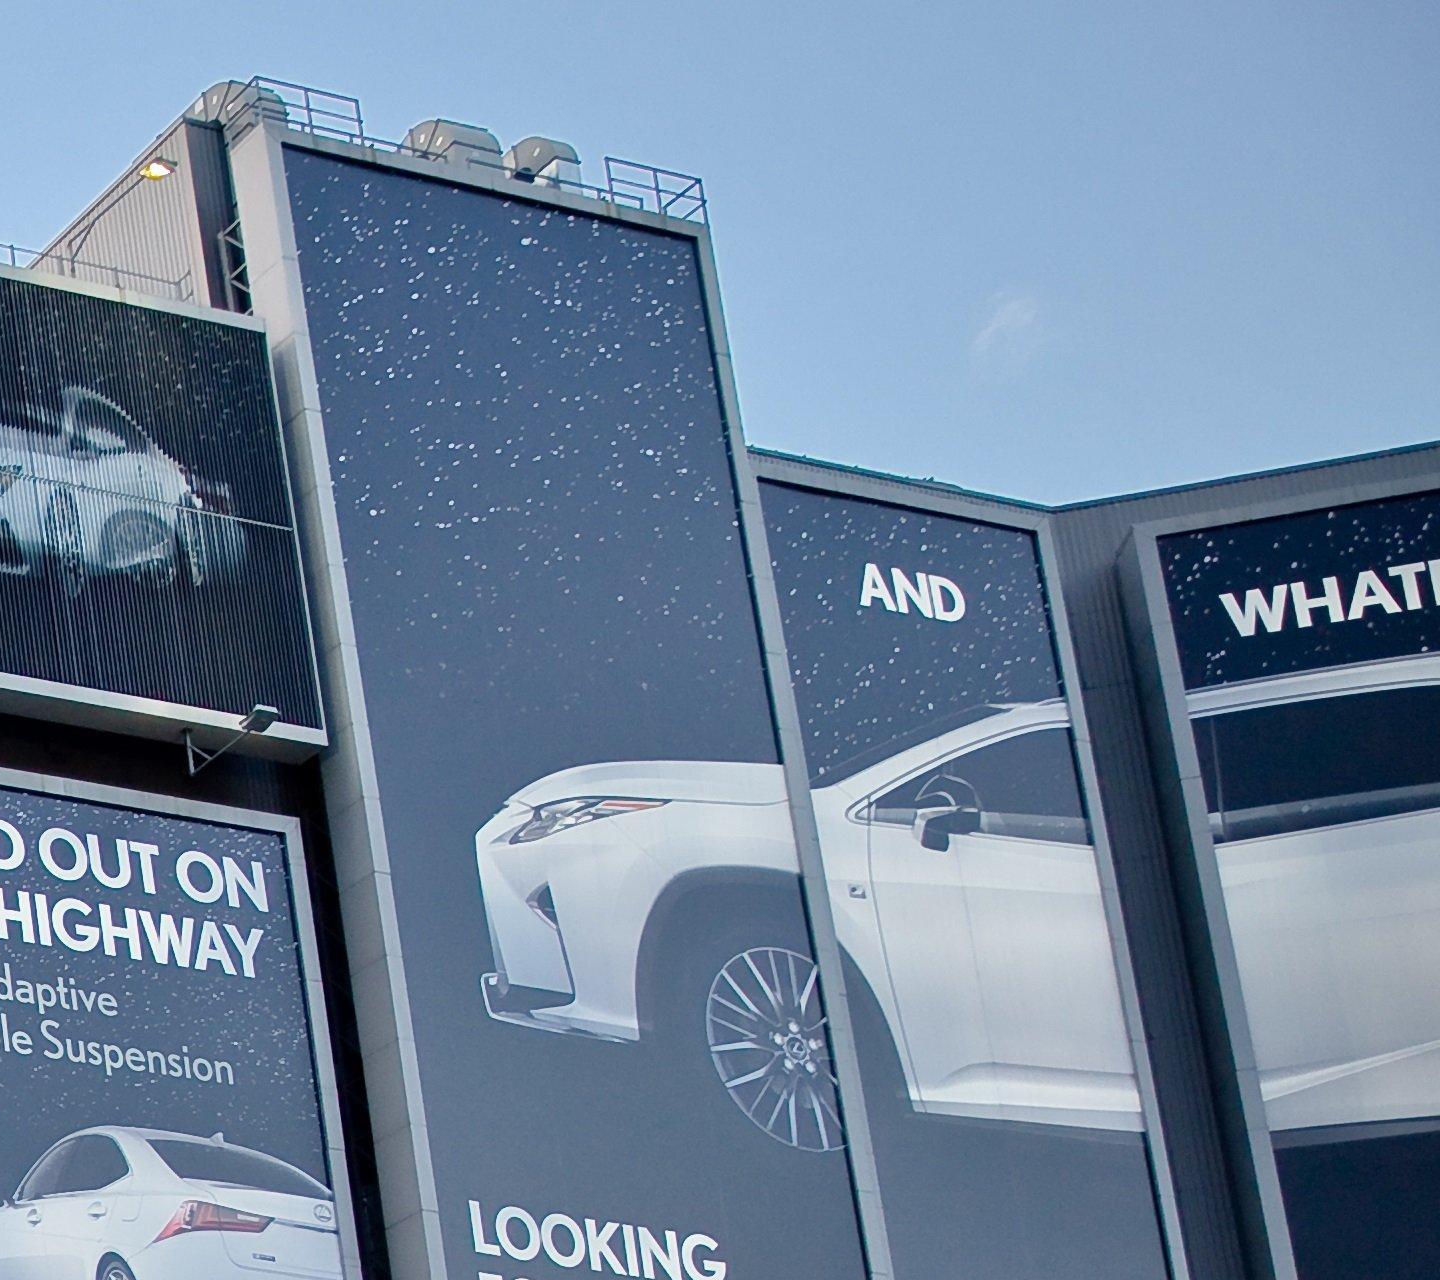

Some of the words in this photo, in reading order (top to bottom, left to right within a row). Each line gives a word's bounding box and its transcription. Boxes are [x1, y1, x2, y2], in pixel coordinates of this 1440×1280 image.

[860, 563, 965, 622] AND
[1219, 559, 1440, 637] WHAT
[38, 828, 160, 894] OUT
[176, 851, 268, 913] ON
[40, 1019, 234, 1085] Suspension
